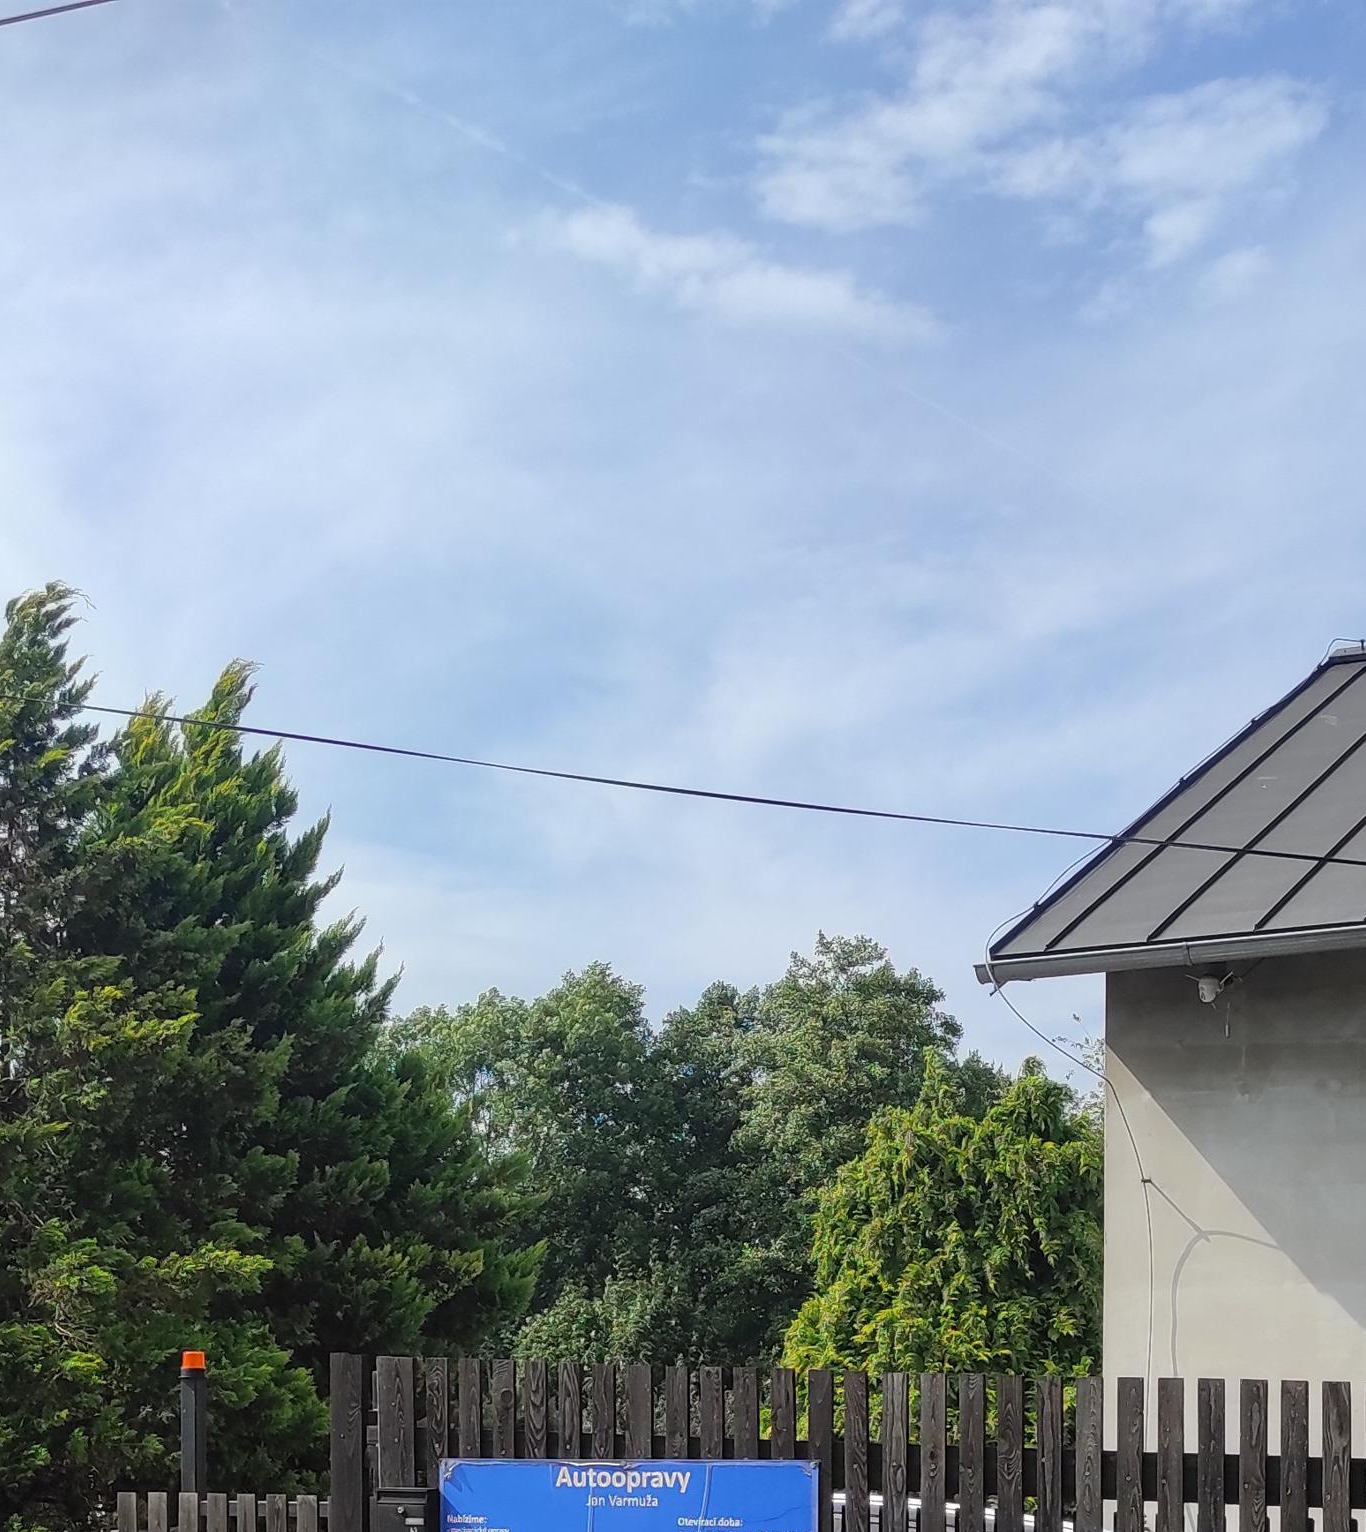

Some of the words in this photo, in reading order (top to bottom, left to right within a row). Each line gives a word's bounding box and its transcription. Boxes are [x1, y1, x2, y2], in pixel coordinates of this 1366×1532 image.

[555, 1466, 691, 1494] Autoopravy
[586, 1494, 605, 1506] Jan
[609, 1494, 659, 1507] Varmuža
[717, 1517, 744, 1527] doba:
